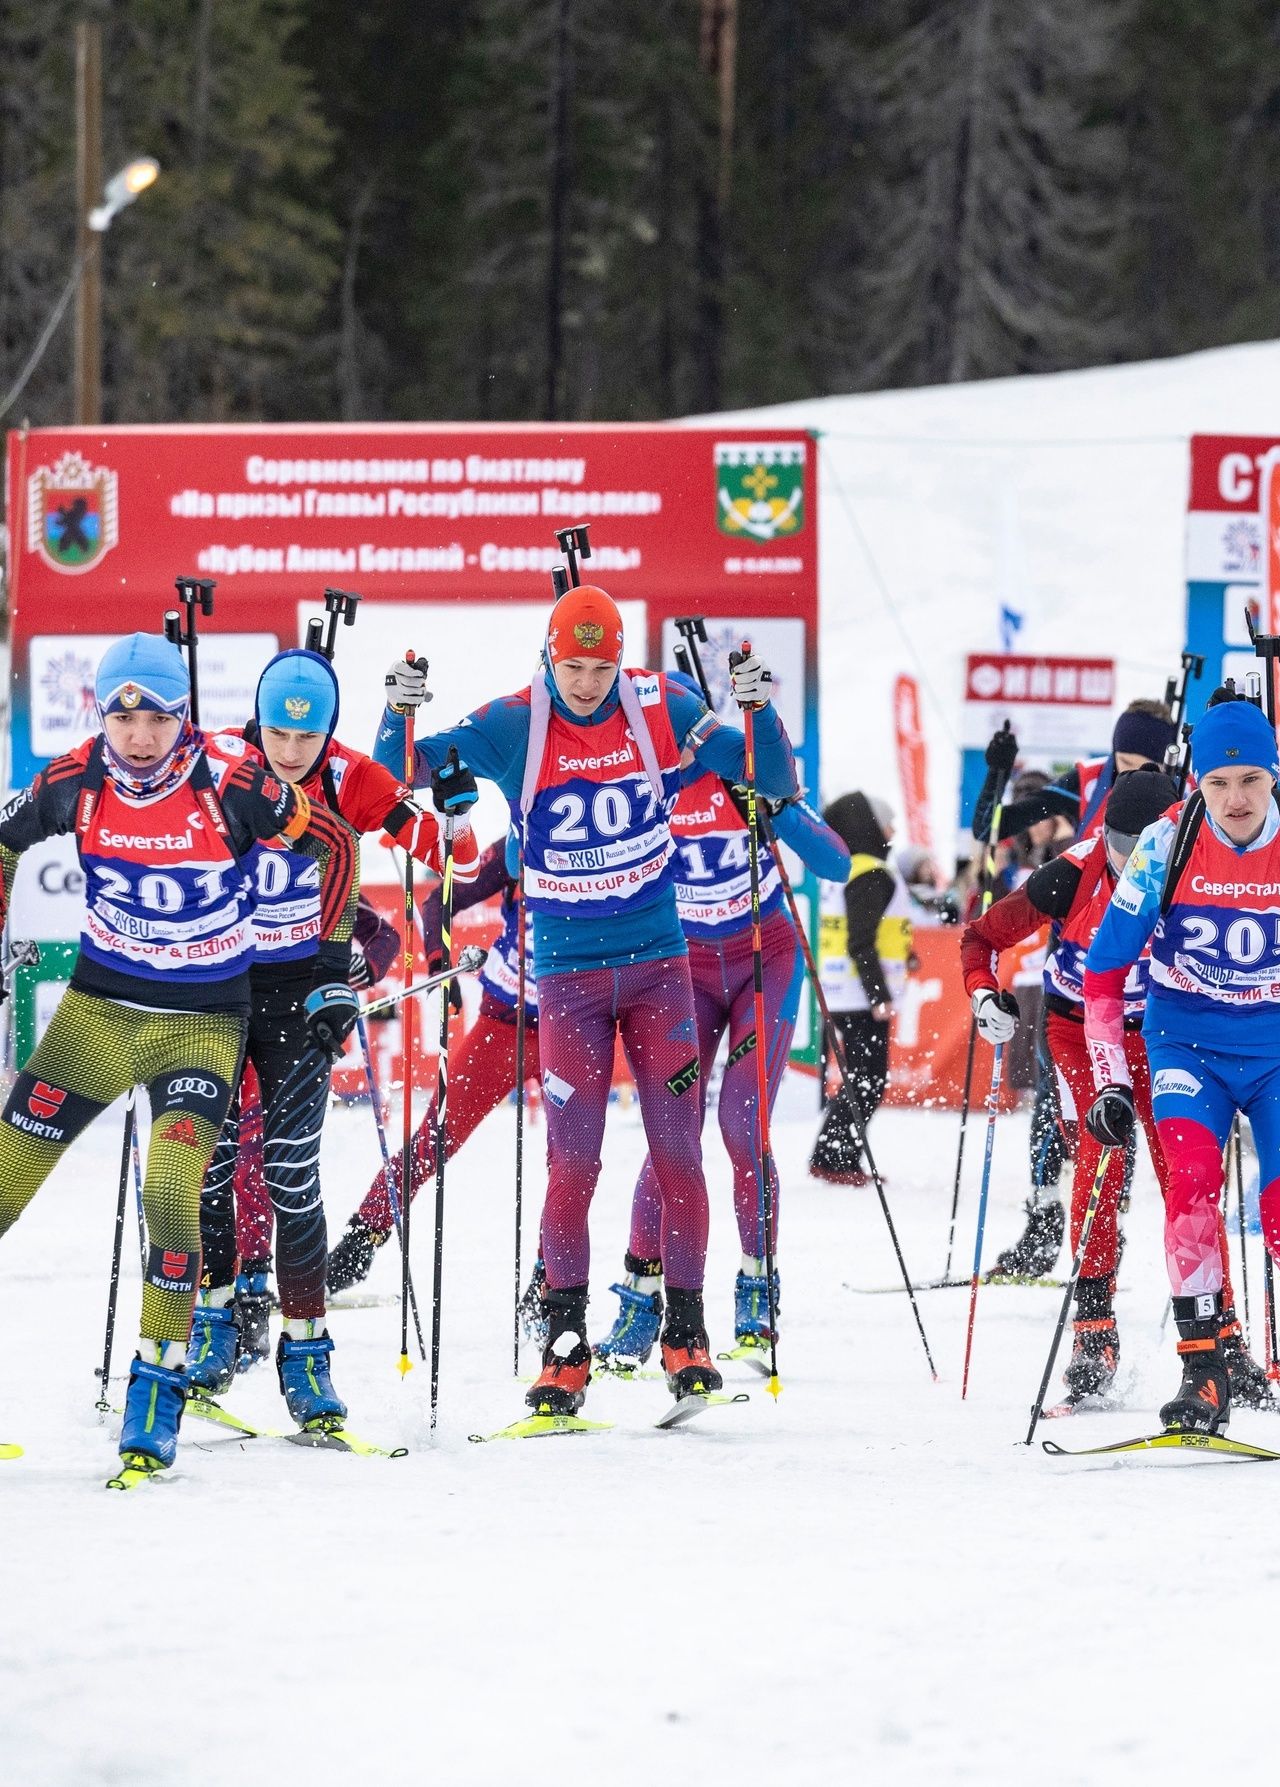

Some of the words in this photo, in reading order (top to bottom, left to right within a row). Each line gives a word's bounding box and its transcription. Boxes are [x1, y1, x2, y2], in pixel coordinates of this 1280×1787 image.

[246, 455, 429, 484] Соревнования
[431, 459, 464, 483] по
[466, 454, 586, 485] биатлону
[217, 493, 302, 520] призы
[304, 489, 385, 517] Главы
[388, 488, 539, 519] Республики
[286, 544, 356, 572] Анны
[359, 543, 464, 572] Богалий
[633, 685, 659, 697] EKA
[558, 743, 634, 772] Severstal
[82, 793, 95, 824] SKIMIR
[203, 792, 222, 824] SKIMIR
[548, 780, 656, 842] 207
[669, 805, 717, 826] verstal
[747, 789, 757, 826] LEKI
[99, 828, 193, 851] Severstal
[568, 849, 605, 869] RYBU
[606, 848, 626, 860] Russian
[678, 832, 753, 881] 14
[256, 850, 320, 898] 04
[594, 874, 625, 891] CUP
[628, 871, 640, 883] &
[92, 865, 229, 914] 201
[677, 886, 694, 900] BU
[169, 948, 183, 958] &
[1166, 964, 1199, 994] КУБОК
[1159, 1081, 1196, 1095] GAZPROM
[1202, 1302, 1212, 1313] 5
[1180, 1435, 1210, 1447] FISCHER
